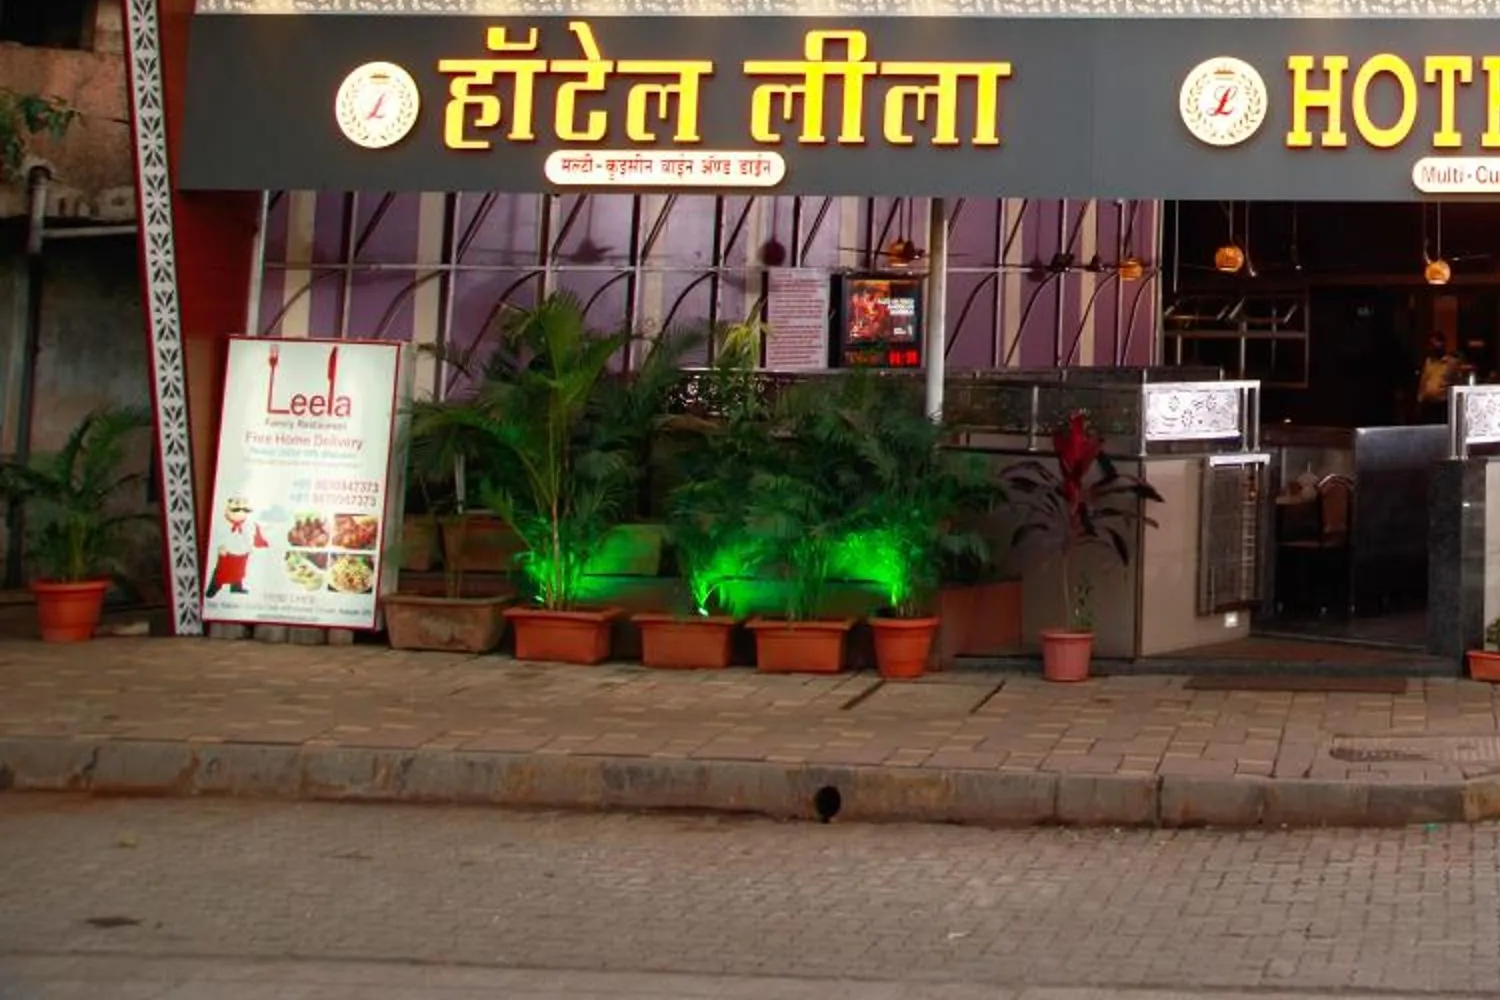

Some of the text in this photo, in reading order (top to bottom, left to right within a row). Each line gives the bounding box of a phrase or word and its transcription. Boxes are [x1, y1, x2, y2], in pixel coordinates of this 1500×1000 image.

[439, 21, 1012, 149] हॉटेल लीला
[267, 344, 351, 417] Leela
